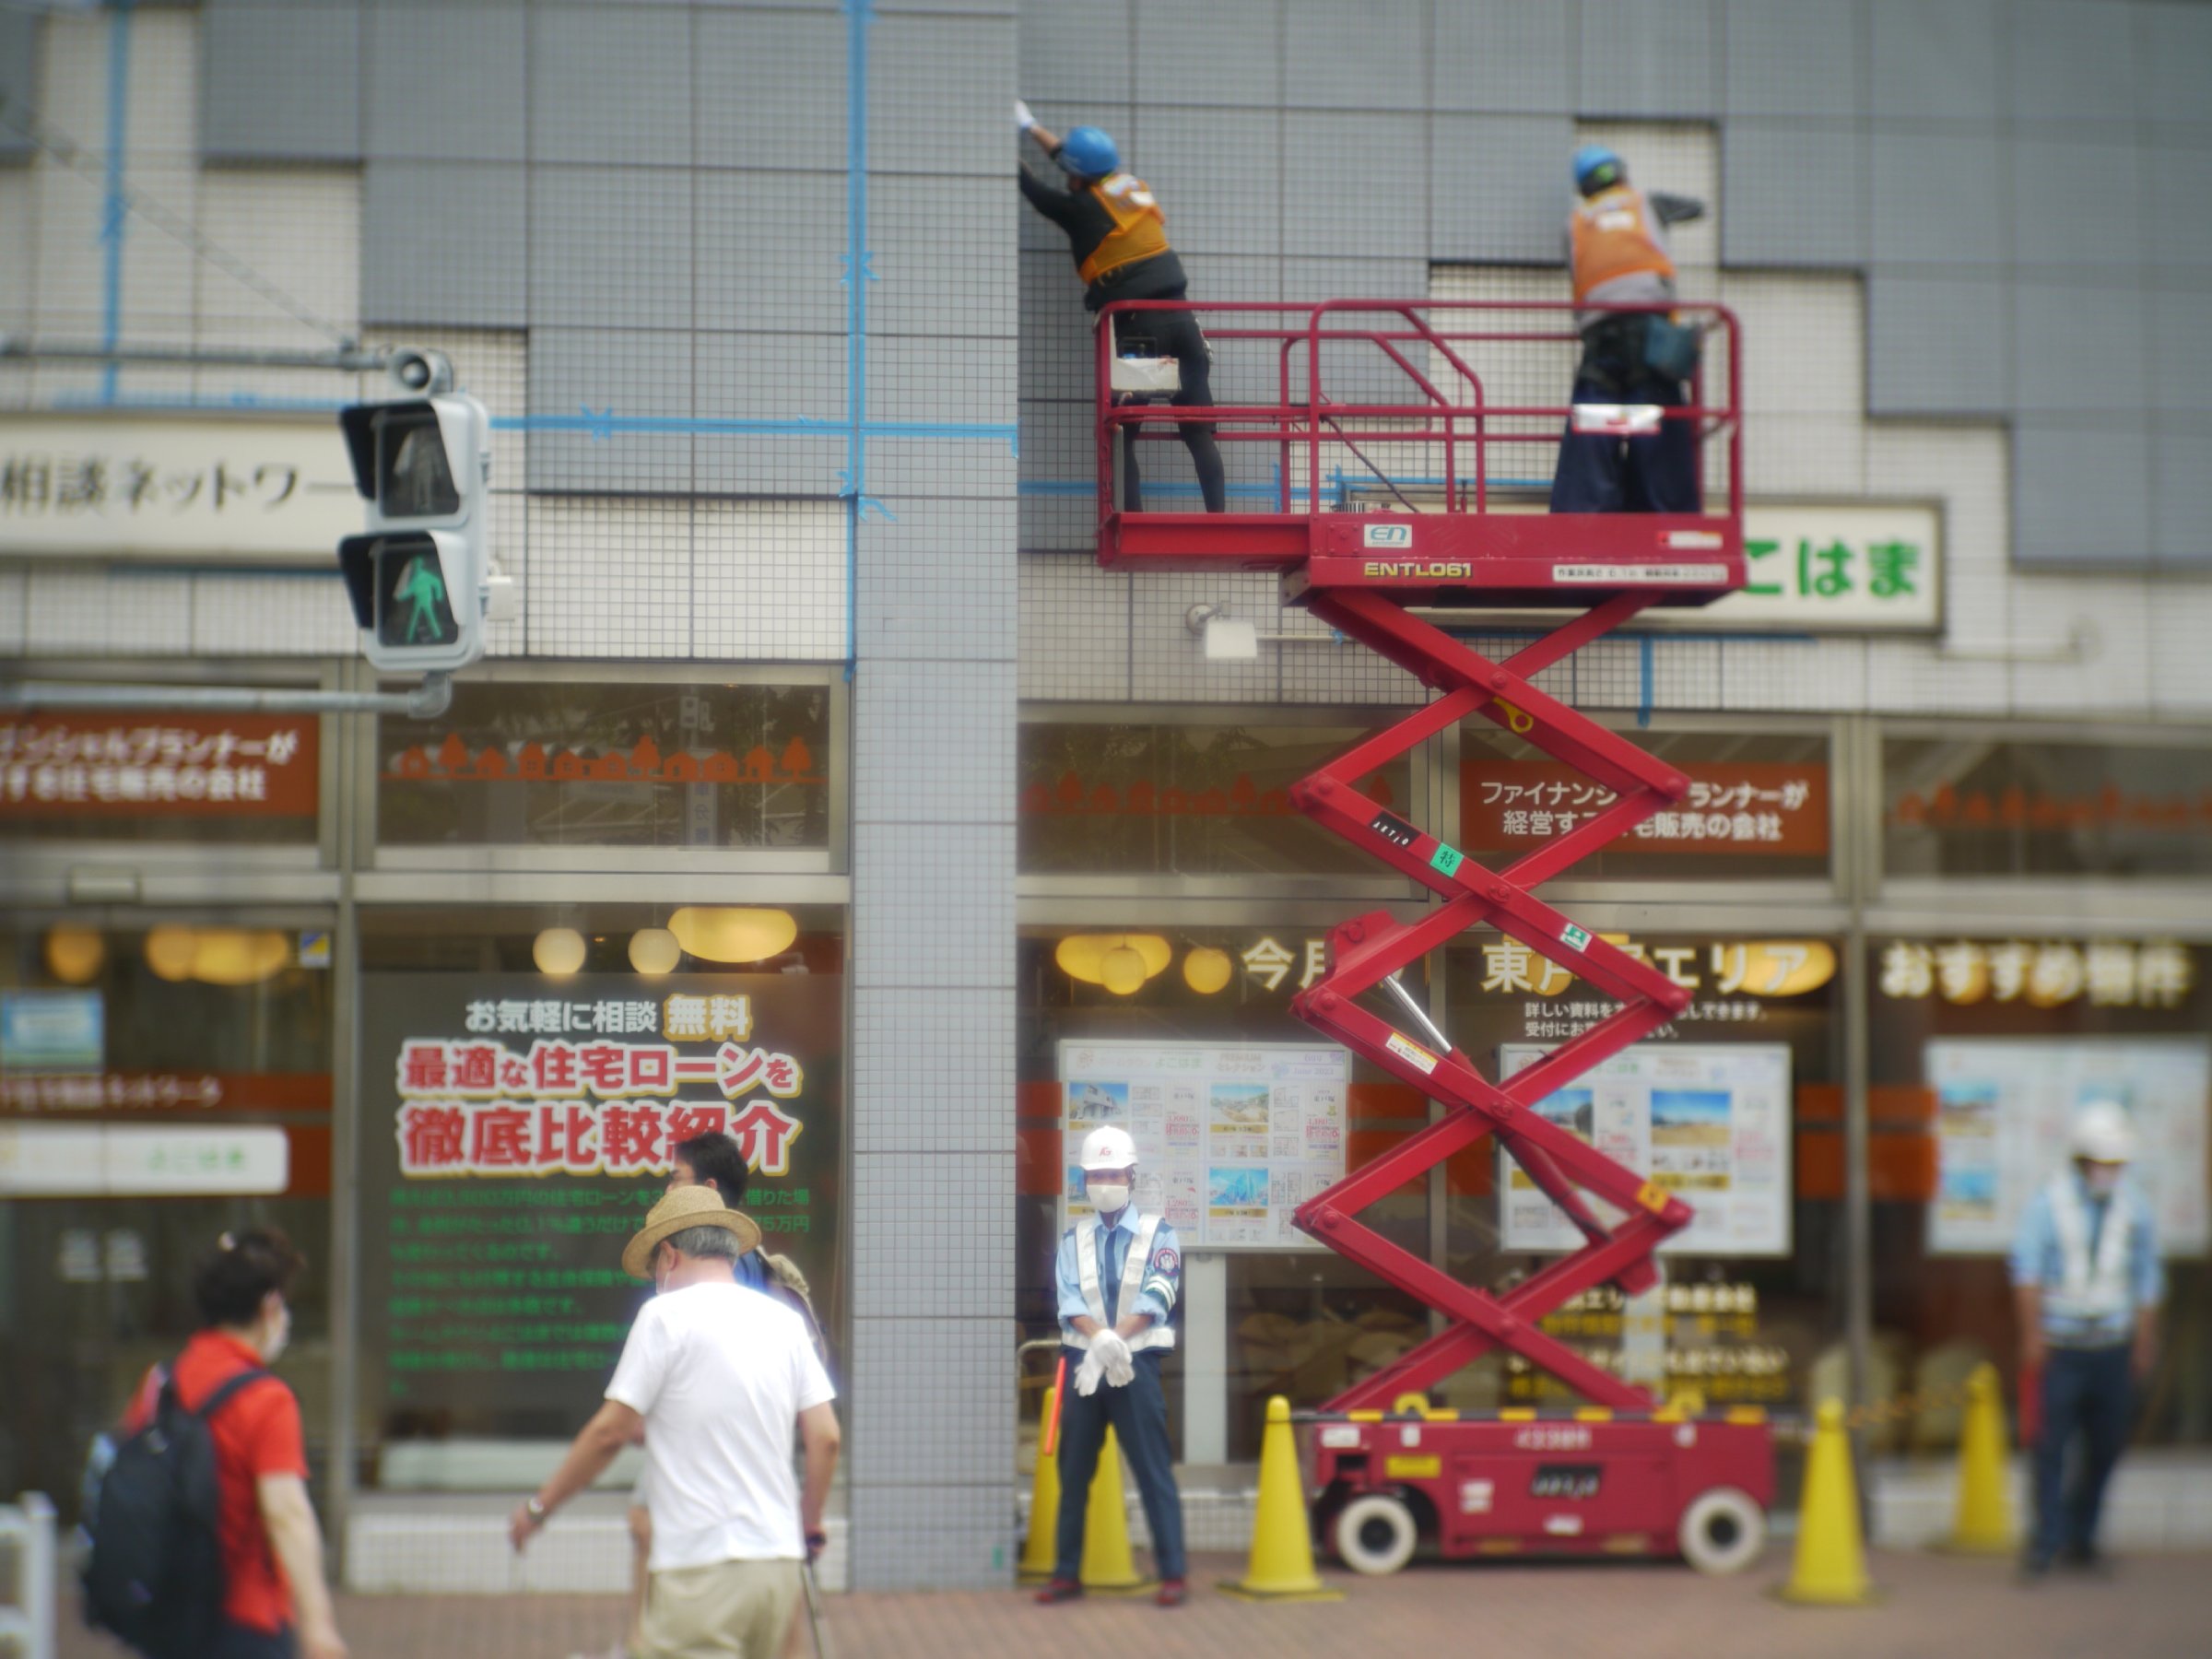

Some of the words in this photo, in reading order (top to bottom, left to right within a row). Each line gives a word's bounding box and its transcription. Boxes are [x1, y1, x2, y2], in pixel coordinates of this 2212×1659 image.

[1364, 561, 1473, 578] ENTL061
[1480, 780, 1810, 811] ファイナンシランナーが
[1503, 809, 1784, 841] 経営す宅販売の会社
[1440, 850, 1456, 868] 特
[465, 999, 658, 1033] お気軽に相談
[665, 994, 752, 1039] 無料
[401, 1041, 799, 1095] 最適な住宅ローンを
